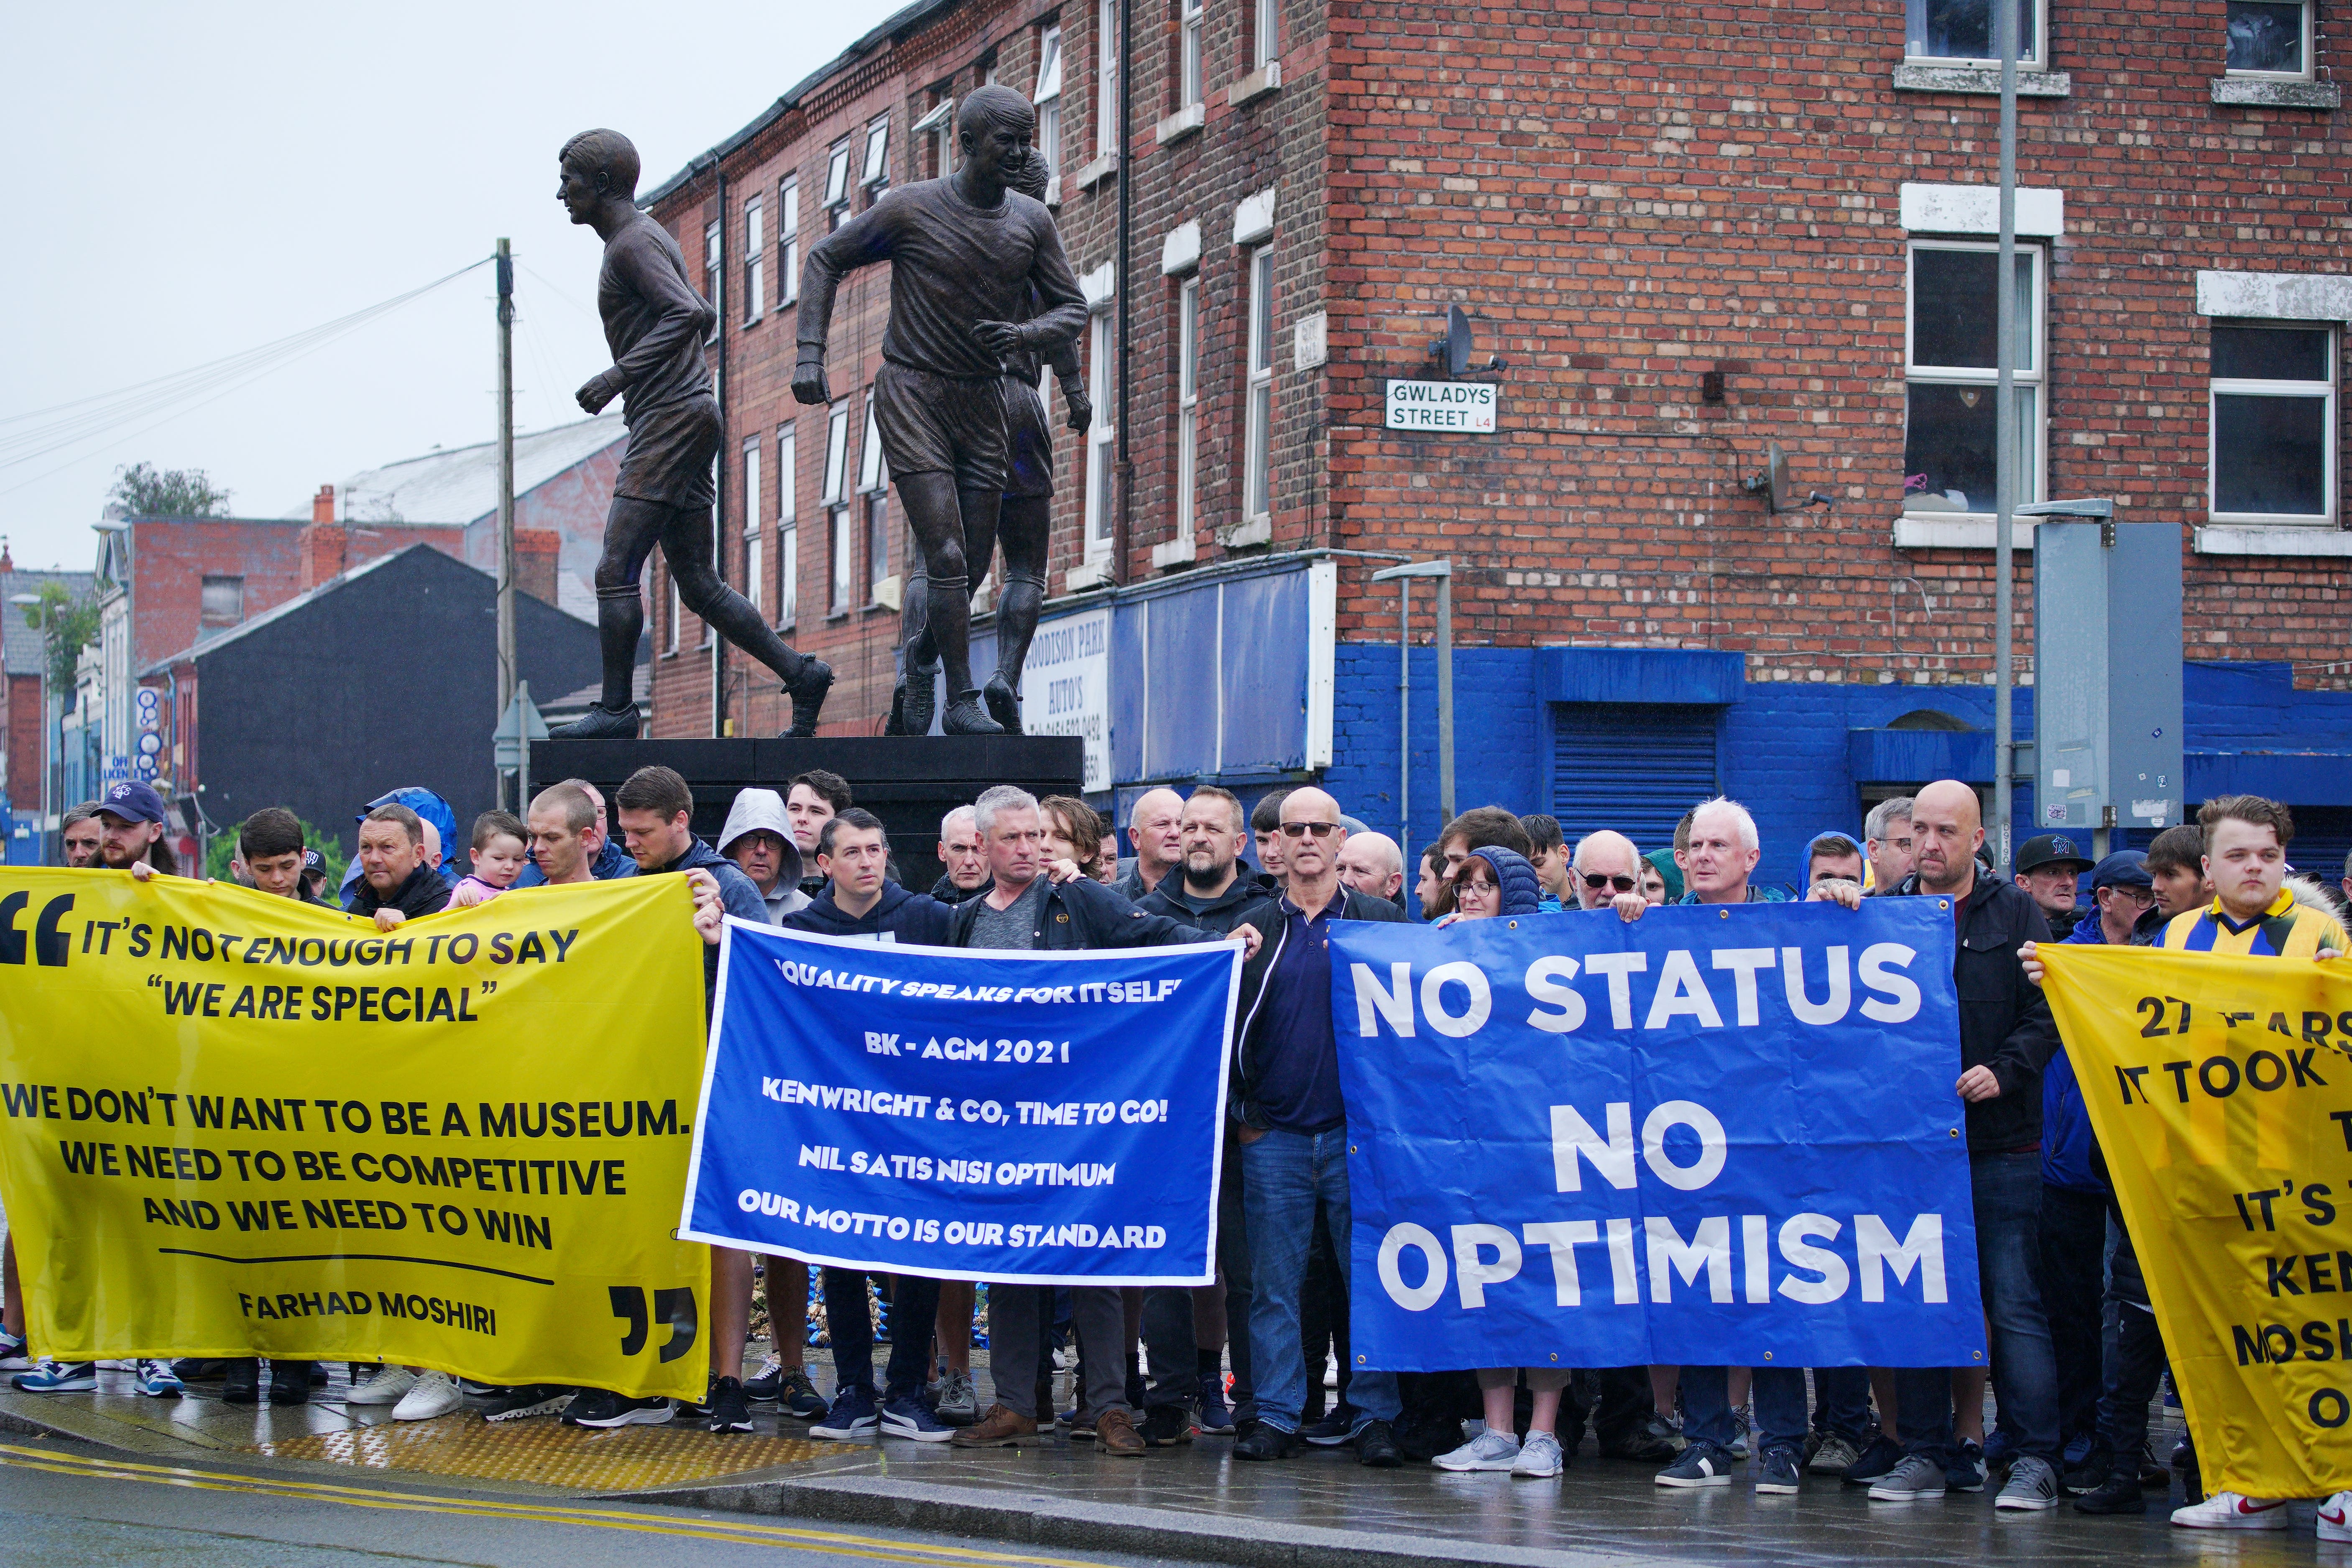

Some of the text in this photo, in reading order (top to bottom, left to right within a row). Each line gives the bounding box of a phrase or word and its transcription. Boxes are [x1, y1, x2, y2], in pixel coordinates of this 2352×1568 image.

[1394, 385, 1490, 404] GWLADYS
[1394, 408, 1490, 426] STREET L4
[1079, 619, 1105, 659] PARK
[1049, 675, 1083, 715] AUTO'S
[103, 769, 138, 779] LICENE
[82, 917, 152, 958] IT'S
[161, 925, 243, 963] NOT
[243, 934, 414, 967] ENOUGH
[426, 933, 478, 964] TO
[489, 929, 579, 964] SAY
[229, 985, 303, 1020] ARE
[900, 981, 1014, 1002] SPEAKS
[1014, 986, 1075, 1004] FOR
[1350, 942, 1922, 1038] NO STATUS
[864, 1031, 901, 1057] BK
[921, 1036, 987, 1062] AGM
[993, 1039, 1070, 1063] 2021
[2137, 996, 2352, 1055] 27 ARS
[762, 1076, 1168, 1126] KENWRIGHT & CO, TIME TO GO!
[2114, 1048, 2329, 1105] IT TOOK
[0, 1083, 691, 1138] WE DON'T WANT TO BE A MUSEUM.
[59, 1140, 626, 1195] WE NEED TO BE COMPETITIVE
[798, 1144, 1116, 1187] NIL SATIS NISI OPTIMUM
[1550, 1100, 1727, 1193] NO
[143, 1197, 552, 1251] AND WE NEED TO WIN
[738, 1188, 1166, 1249] OUR MOTTO IS OUR STANDARD
[2233, 1179, 2336, 1232] IT'S
[1376, 1213, 1949, 1312] OPTIMISM
[239, 1291, 496, 1336] FARHAD MOSHIRI
